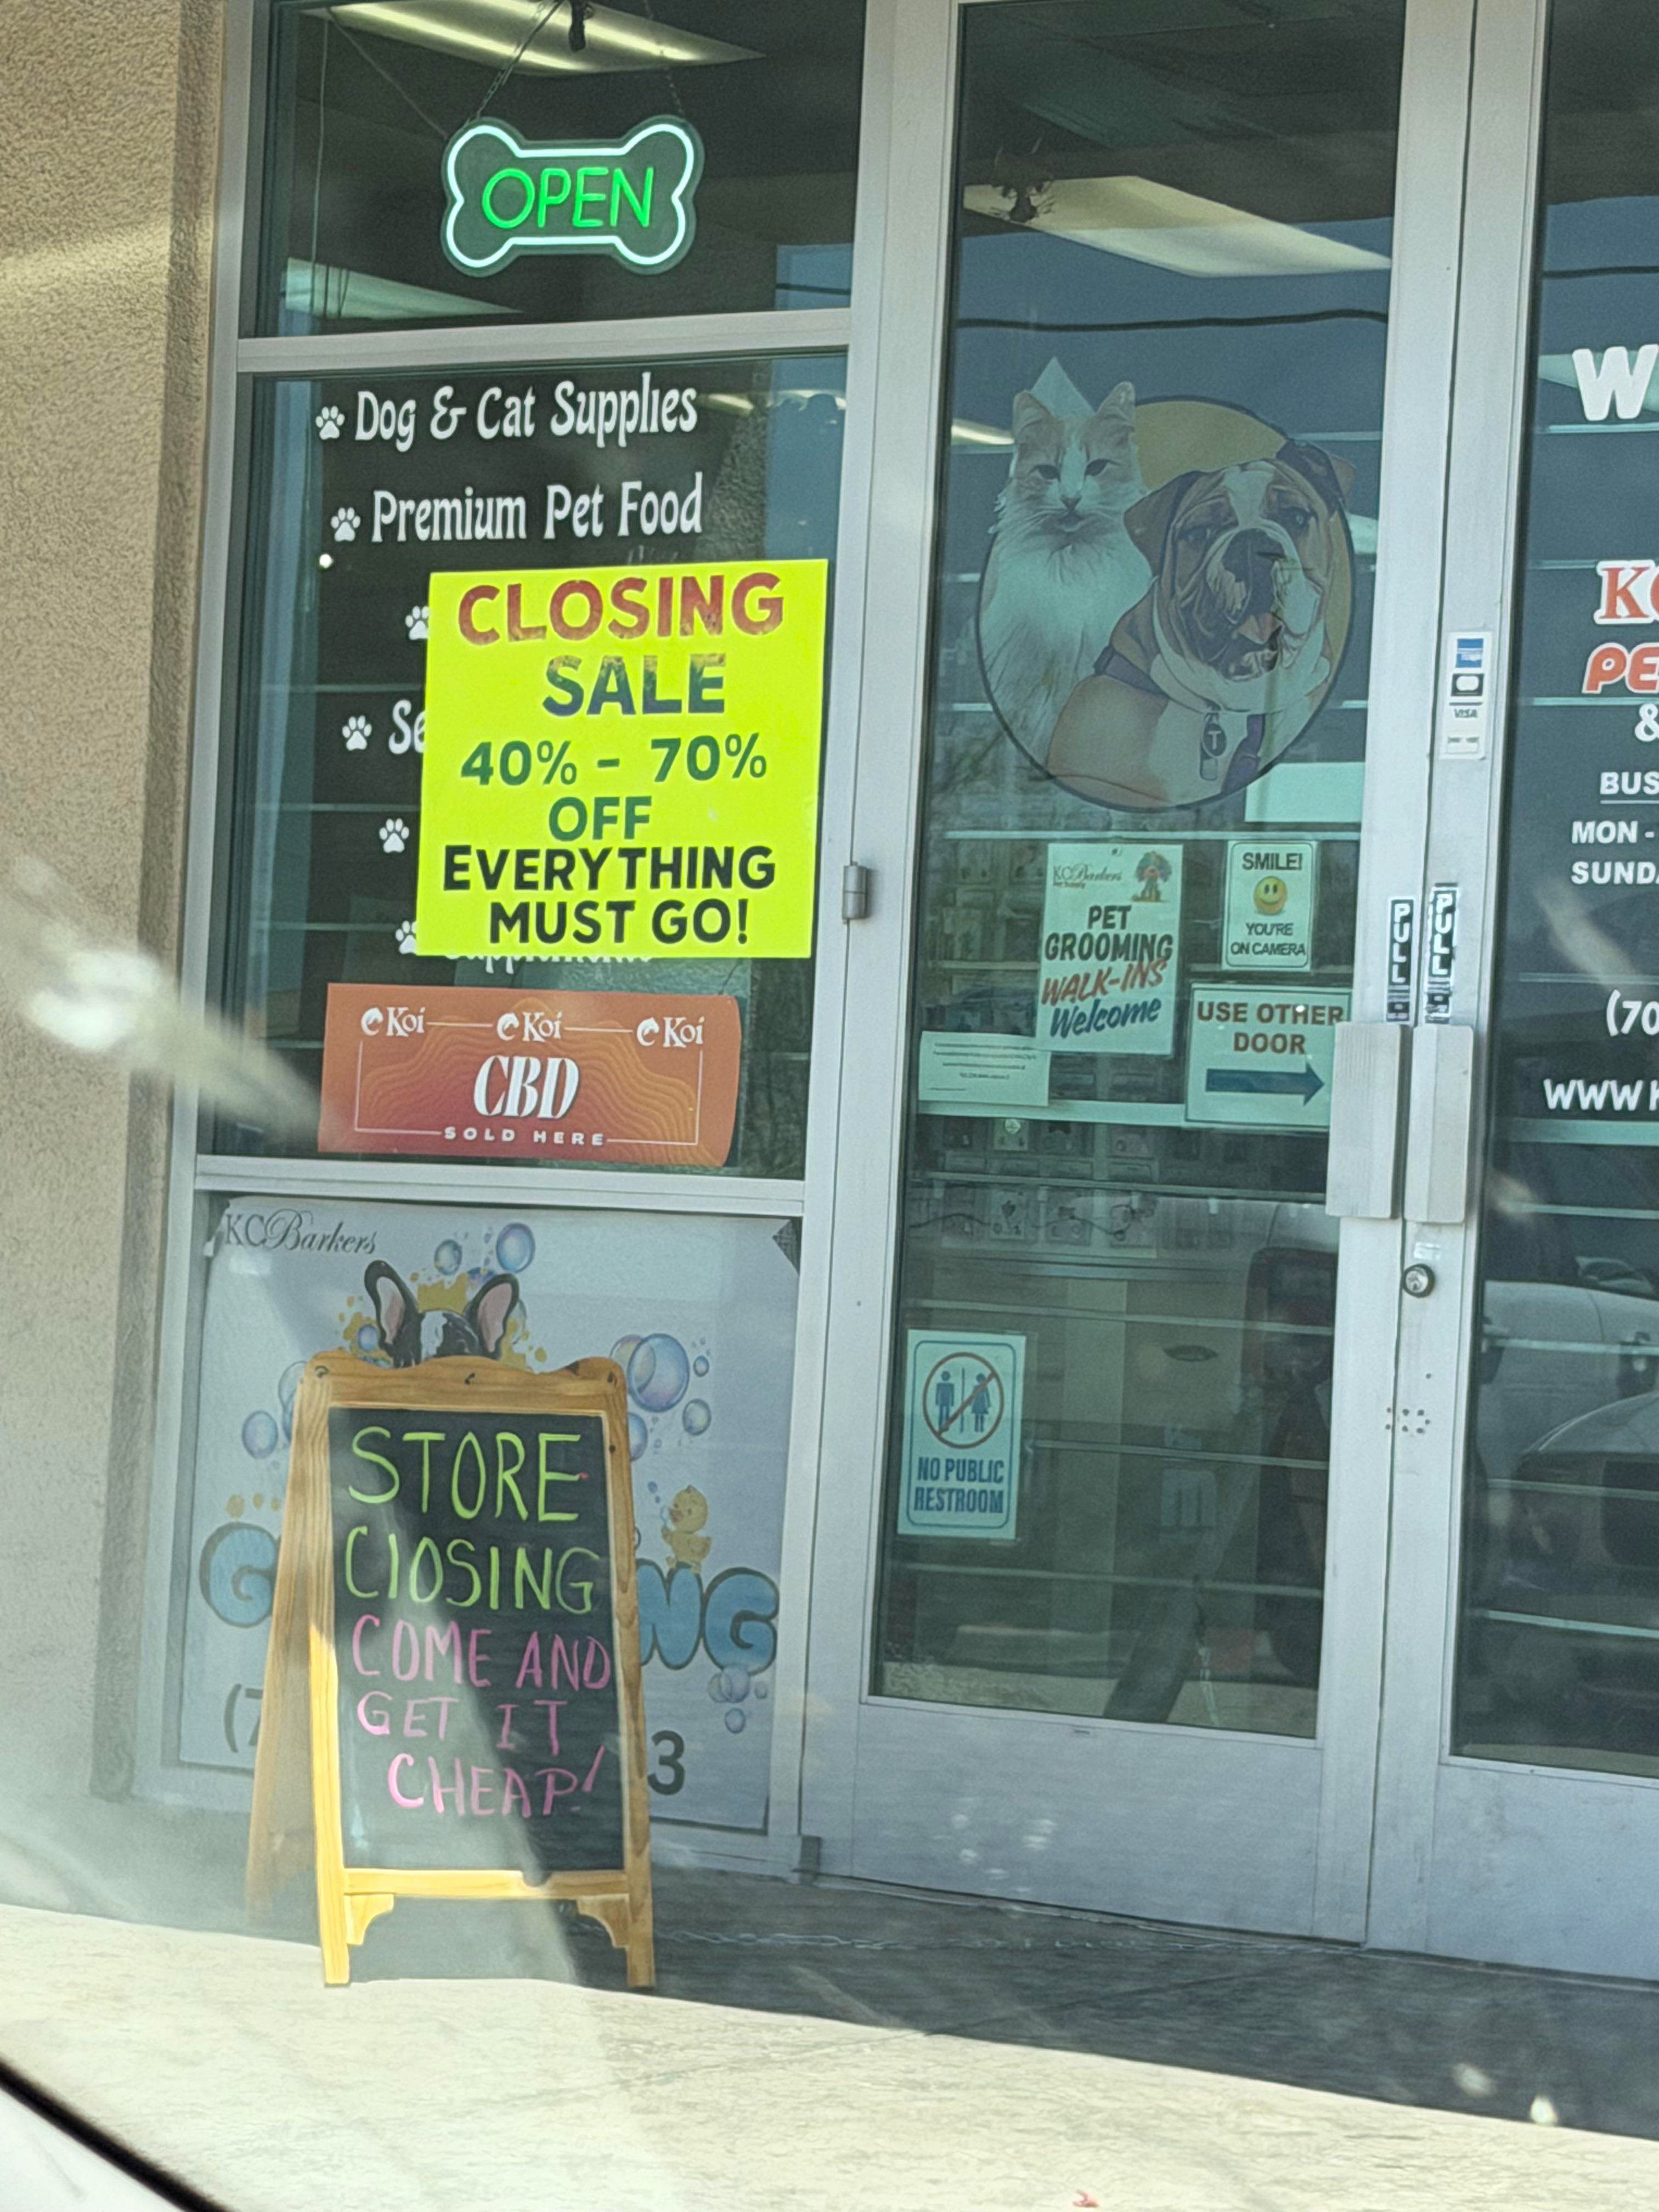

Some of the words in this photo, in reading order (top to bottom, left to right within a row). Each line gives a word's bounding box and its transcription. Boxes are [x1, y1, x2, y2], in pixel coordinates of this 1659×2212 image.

[482, 166, 654, 228] OPEN
[355, 391, 416, 452] Dog
[430, 385, 467, 439] &
[476, 386, 536, 439] Cat
[550, 371, 698, 448] Supplies
[371, 487, 527, 543] Premium
[544, 484, 605, 540] Pet
[617, 471, 703, 537] Food
[458, 572, 785, 646] CLOSING
[541, 653, 726, 717] SALE
[460, 740, 578, 786] 40%
[650, 732, 768, 783] 70%
[548, 795, 653, 842] OFF
[1571, 820, 1638, 844] MON
[442, 844, 776, 892] EVERYTHING
[1242, 852, 1303, 871] SMILE!
[1571, 861, 1659, 885] SUND
[489, 900, 636, 945] MUST
[651, 897, 749, 945] GO!
[1087, 905, 1132, 930] PET
[1246, 922, 1294, 937] YOU'RE
[1432, 893, 1453, 975] PULL
[1045, 932, 1174, 962] GROOMING
[1231, 941, 1250, 955] ON
[1252, 942, 1307, 956] CAMERA
[1391, 903, 1410, 983] PULL
[1041, 956, 1167, 1007] WALK-INS
[386, 1006, 426, 1037] Koi
[522, 1011, 562, 1042] Koi
[662, 1016, 706, 1048] Koi
[1050, 997, 1162, 1039] Welcome
[1197, 1001, 1249, 1023] USE
[1256, 1003, 1344, 1026] OTHER
[1233, 1032, 1307, 1054] DOOR
[473, 1054, 580, 1120] CBD
[443, 1126, 516, 1143] SOLD
[533, 1130, 605, 1147] HERE
[348, 1426, 582, 1522] STORE
[917, 1457, 940, 1481] NO
[945, 1458, 1005, 1484] PUBLIC
[913, 1486, 1003, 1514] RESTROOM
[352, 1613, 492, 1688] COME
[515, 1630, 611, 1692] AND
[357, 1690, 460, 1741] GET
[496, 1699, 568, 1756] IT
[387, 1745, 605, 1819] CHEAP!
